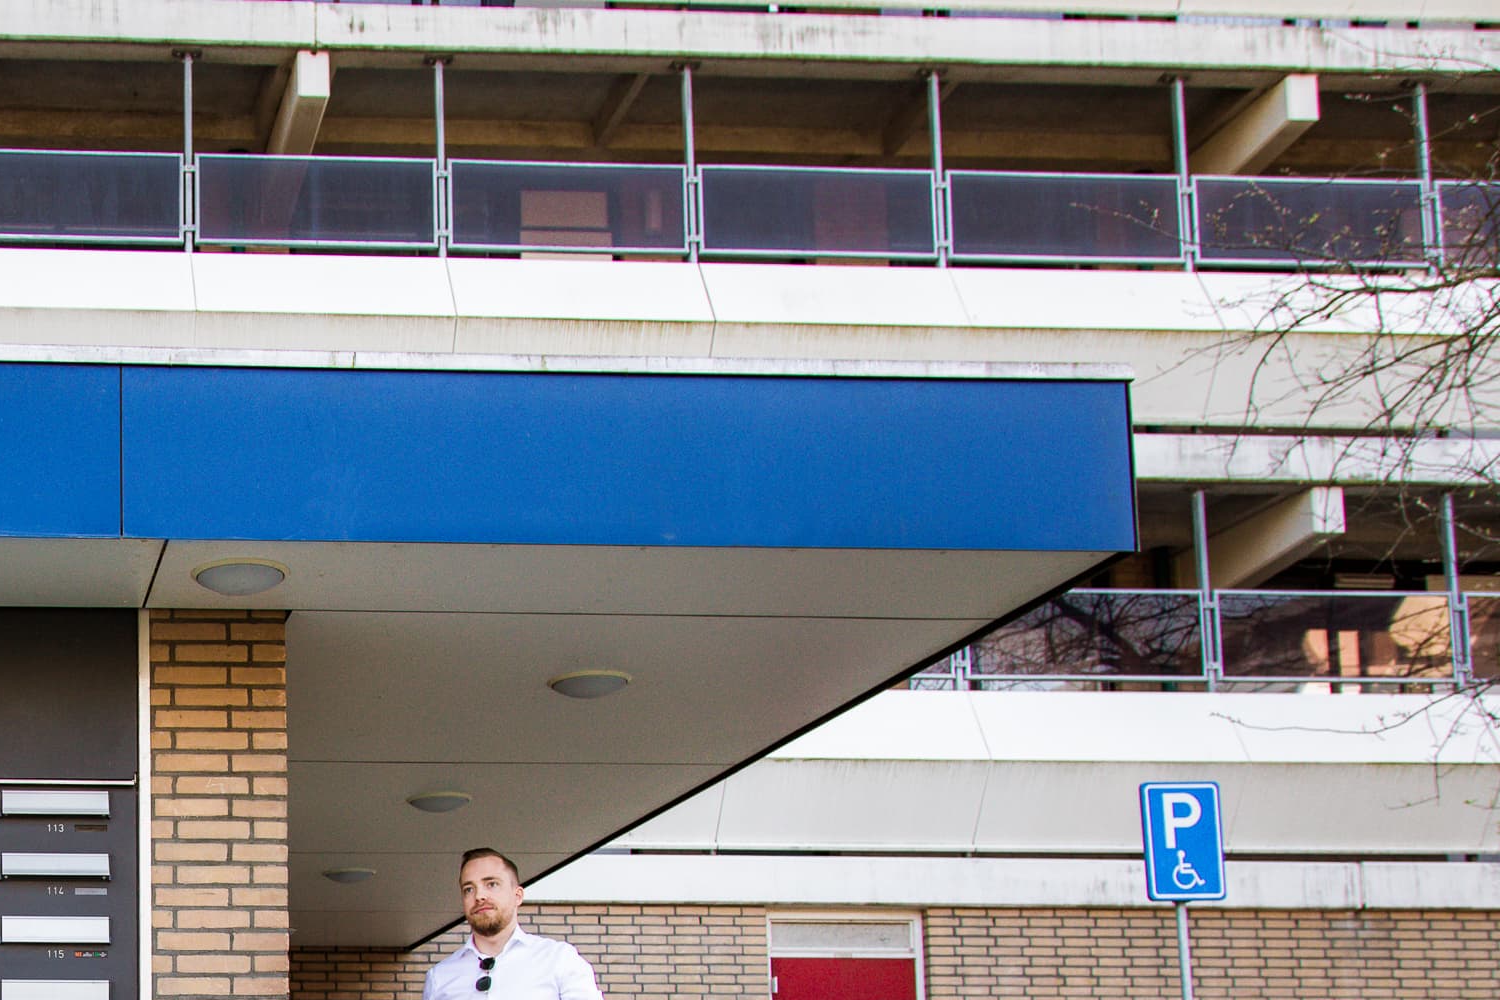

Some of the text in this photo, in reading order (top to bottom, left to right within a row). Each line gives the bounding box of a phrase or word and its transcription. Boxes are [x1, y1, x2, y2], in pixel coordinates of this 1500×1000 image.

[1162, 792, 1202, 849] P
[47, 823, 65, 833] 113
[47, 886, 64, 896] 114
[47, 949, 65, 959] 115
